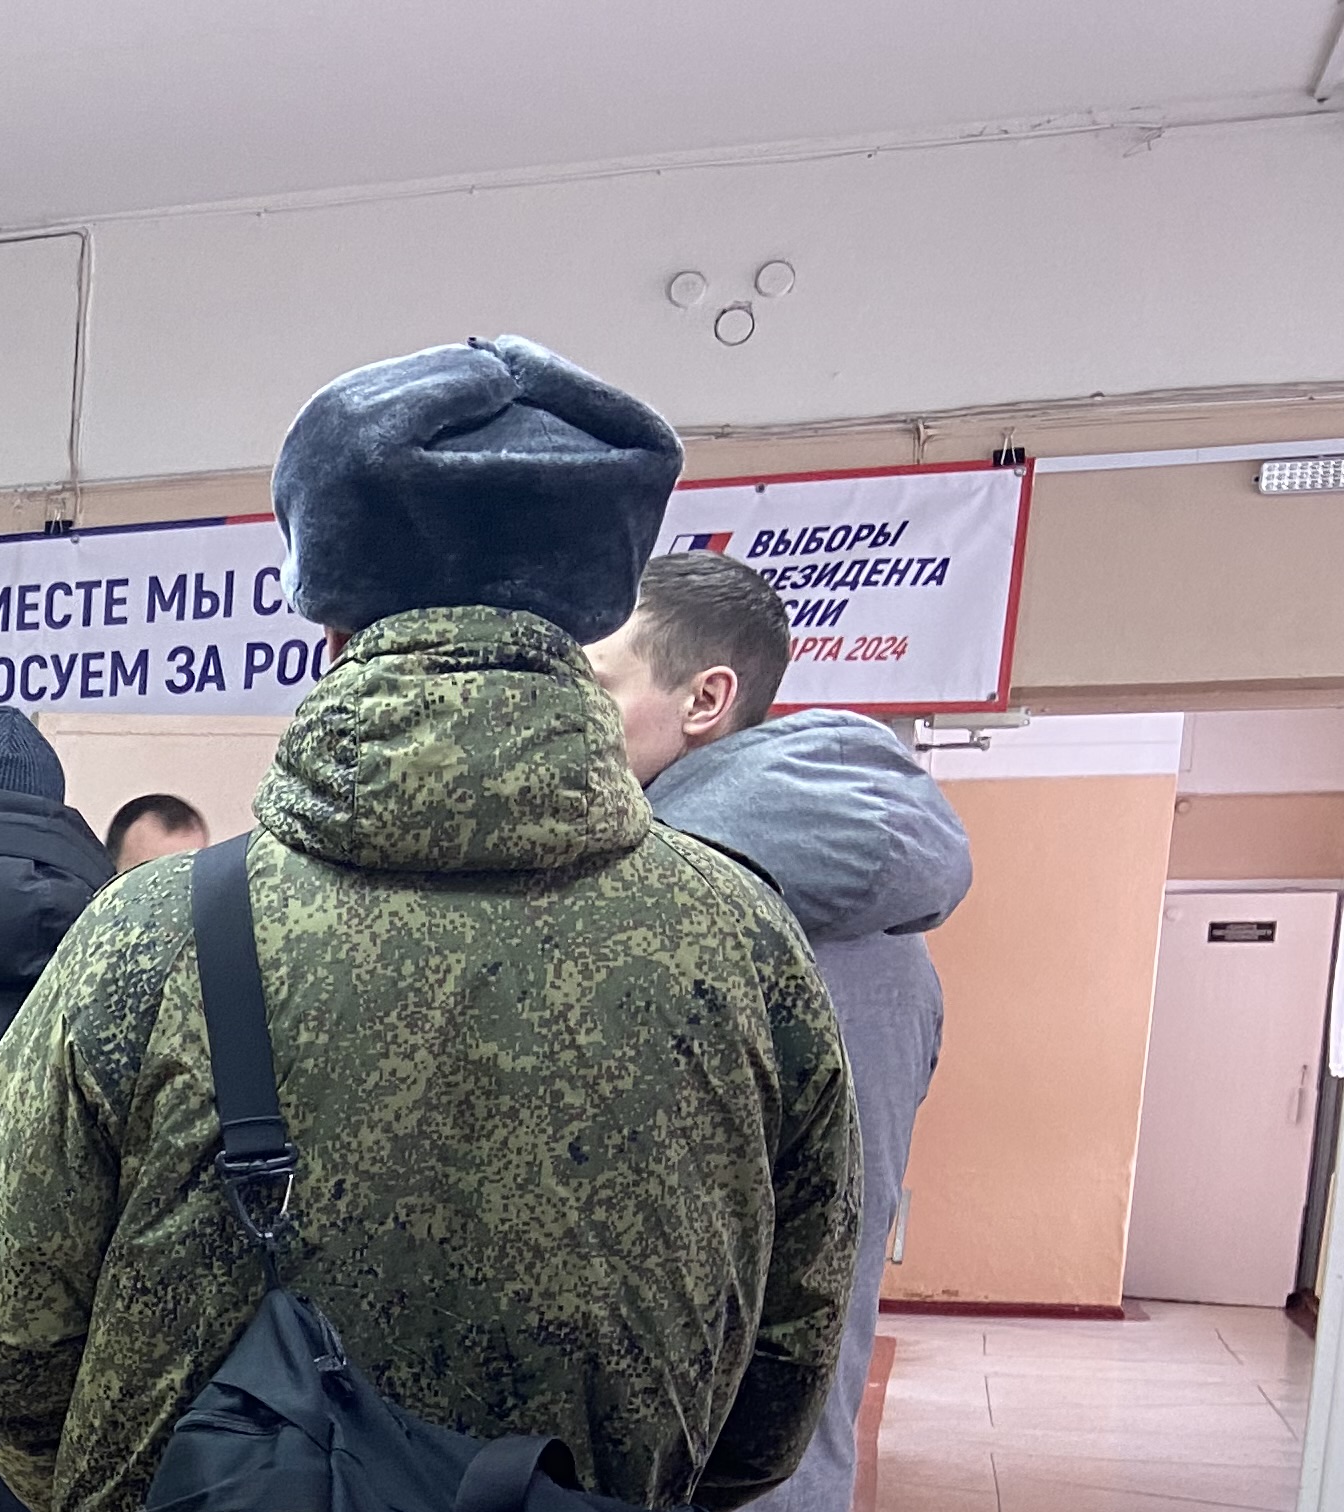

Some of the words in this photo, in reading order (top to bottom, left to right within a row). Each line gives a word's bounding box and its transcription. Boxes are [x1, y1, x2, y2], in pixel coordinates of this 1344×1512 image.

[746, 520, 910, 559] ВЫБОРЫ
[760, 556, 951, 591] РЕЗИДЕНТА
[146, 570, 235, 623] МЫ
[844, 635, 908, 661] 2024
[165, 645, 226, 694] ЗА
